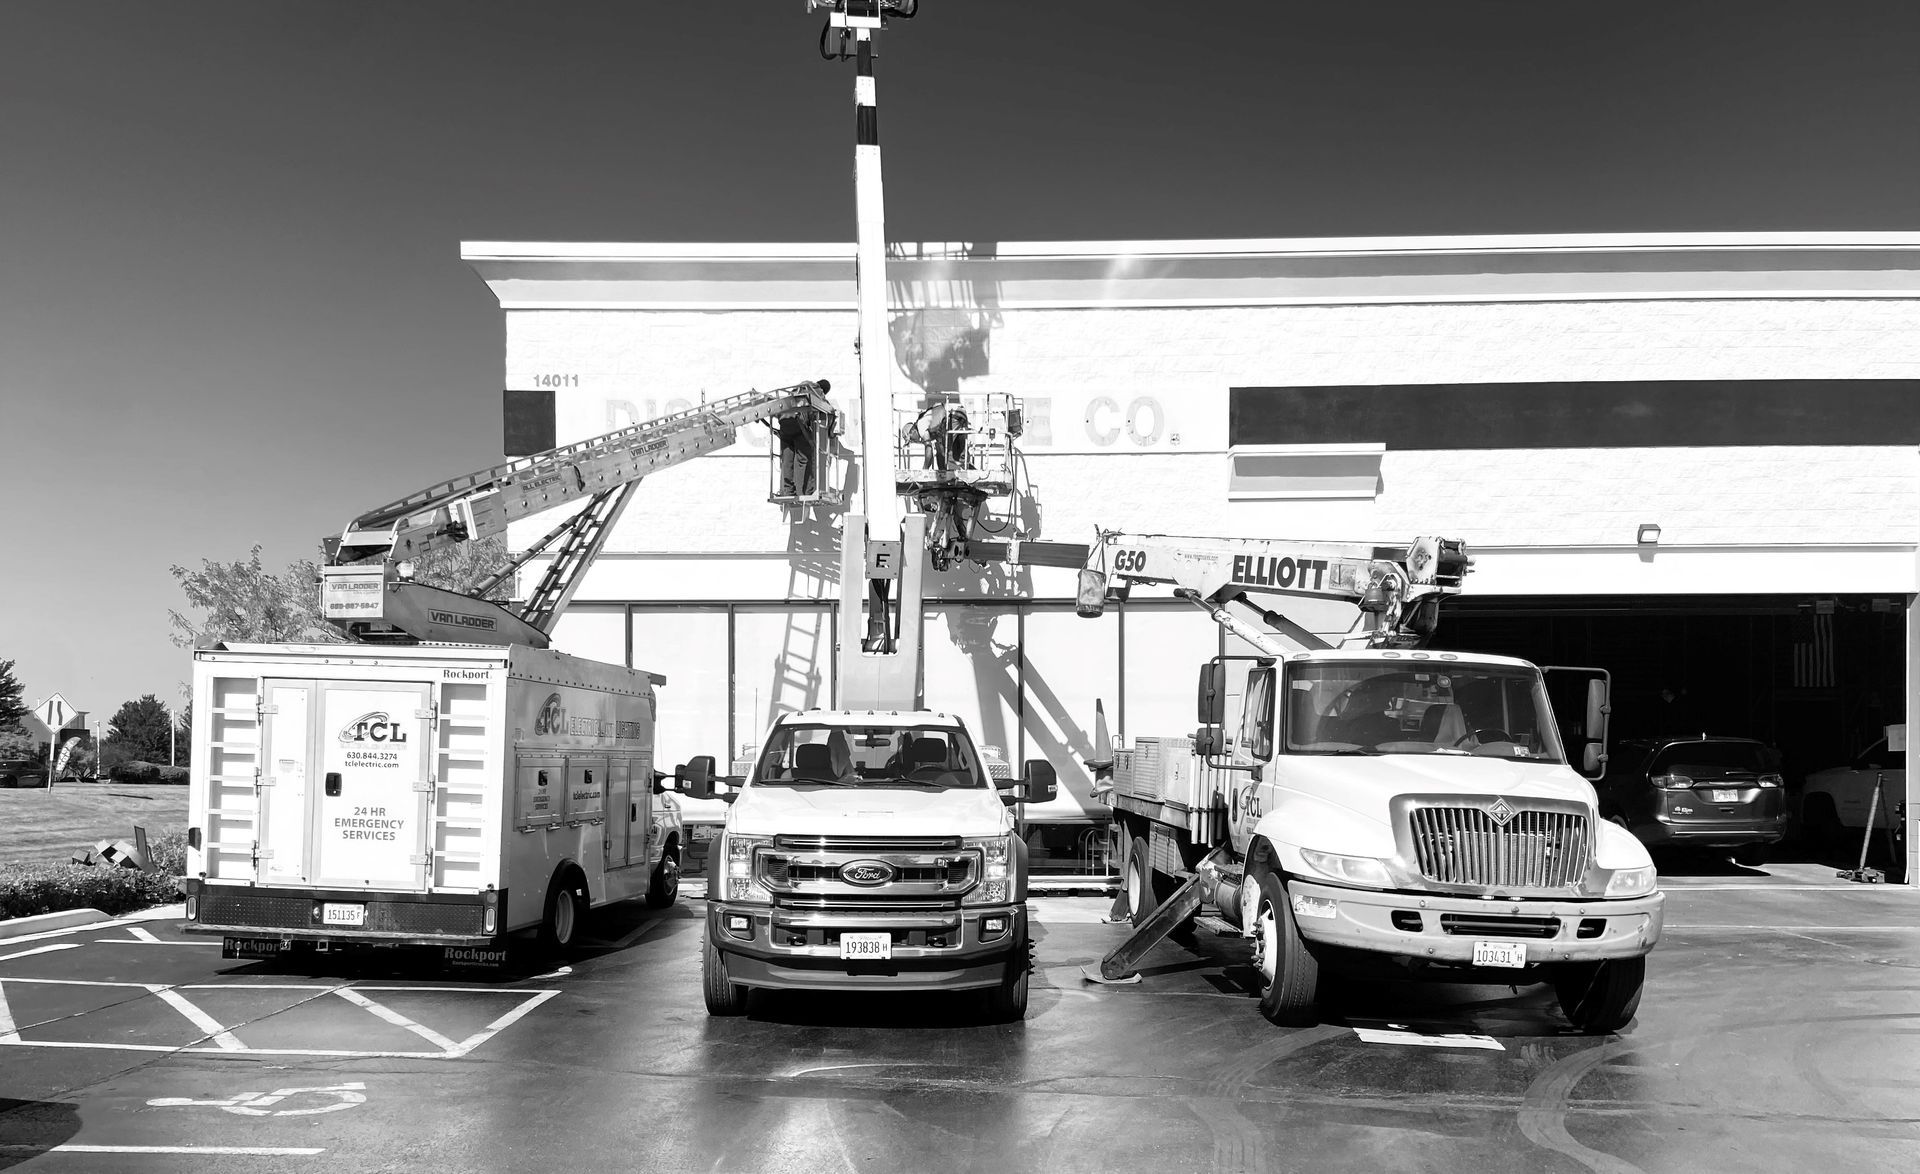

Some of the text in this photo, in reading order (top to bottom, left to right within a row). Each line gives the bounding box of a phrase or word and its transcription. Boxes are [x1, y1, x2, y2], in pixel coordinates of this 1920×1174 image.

[533, 374, 579, 387] 14011
[1084, 395, 1181, 447] CO.
[876, 553, 890, 568] E
[1114, 549, 1147, 573] G50
[1232, 554, 1328, 591] ELLIOTT
[431, 612, 495, 629] VAN LADDER
[443, 669, 489, 680] Rockport
[543, 707, 569, 735] TCL
[354, 722, 407, 743] TCL
[346, 752, 398, 760] 630.844.3274
[345, 760, 399, 768] tclelectric.com
[354, 806, 386, 817] 24 HR
[1246, 796, 1262, 818] TCL
[334, 817, 404, 829] EMERGENCY
[342, 830, 396, 841] SERVICES
[854, 867, 881, 879] Ford
[328, 909, 355, 921] 151135
[224, 938, 281, 953] Rockpor
[846, 941, 888, 954] 193838 H
[444, 947, 507, 962] Rockport
[1517, 953, 1523, 962] H
